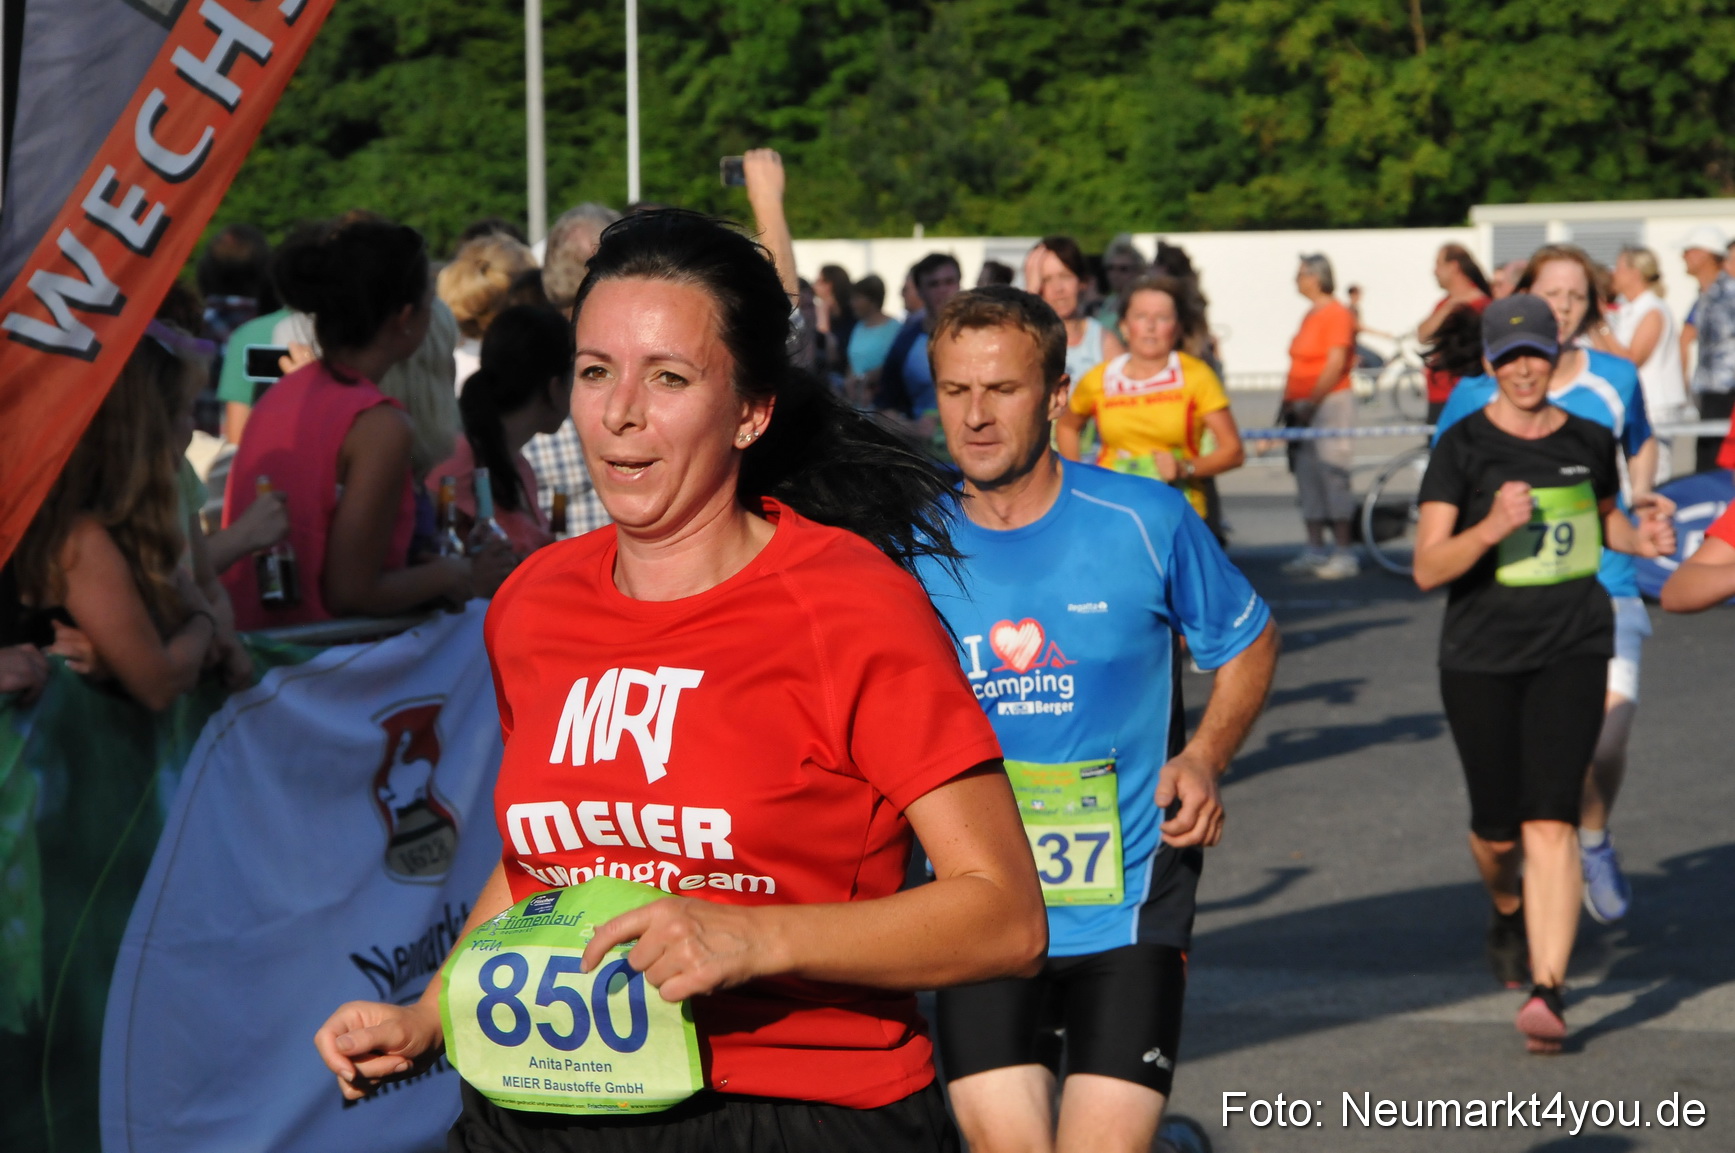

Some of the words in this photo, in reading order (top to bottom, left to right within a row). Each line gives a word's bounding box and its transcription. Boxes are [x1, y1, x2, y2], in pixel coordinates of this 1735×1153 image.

[1, 0, 308, 363] WECH
[1528, 521, 1575, 558] 79
[963, 634, 988, 679] I
[971, 669, 1075, 701] camping
[549, 666, 705, 784] MRT
[1035, 701, 1074, 716] Berger
[506, 800, 735, 860] MEIER
[1030, 832, 1111, 884] 37
[504, 911, 585, 929] firmenlauf
[476, 952, 649, 1053] 850
[502, 1075, 541, 1089] MEIER
[544, 1079, 601, 1092] Baustoffe
[605, 1082, 644, 1094] GmbH
[529, 1056, 562, 1070] Anita
[565, 1059, 612, 1072] Panten
